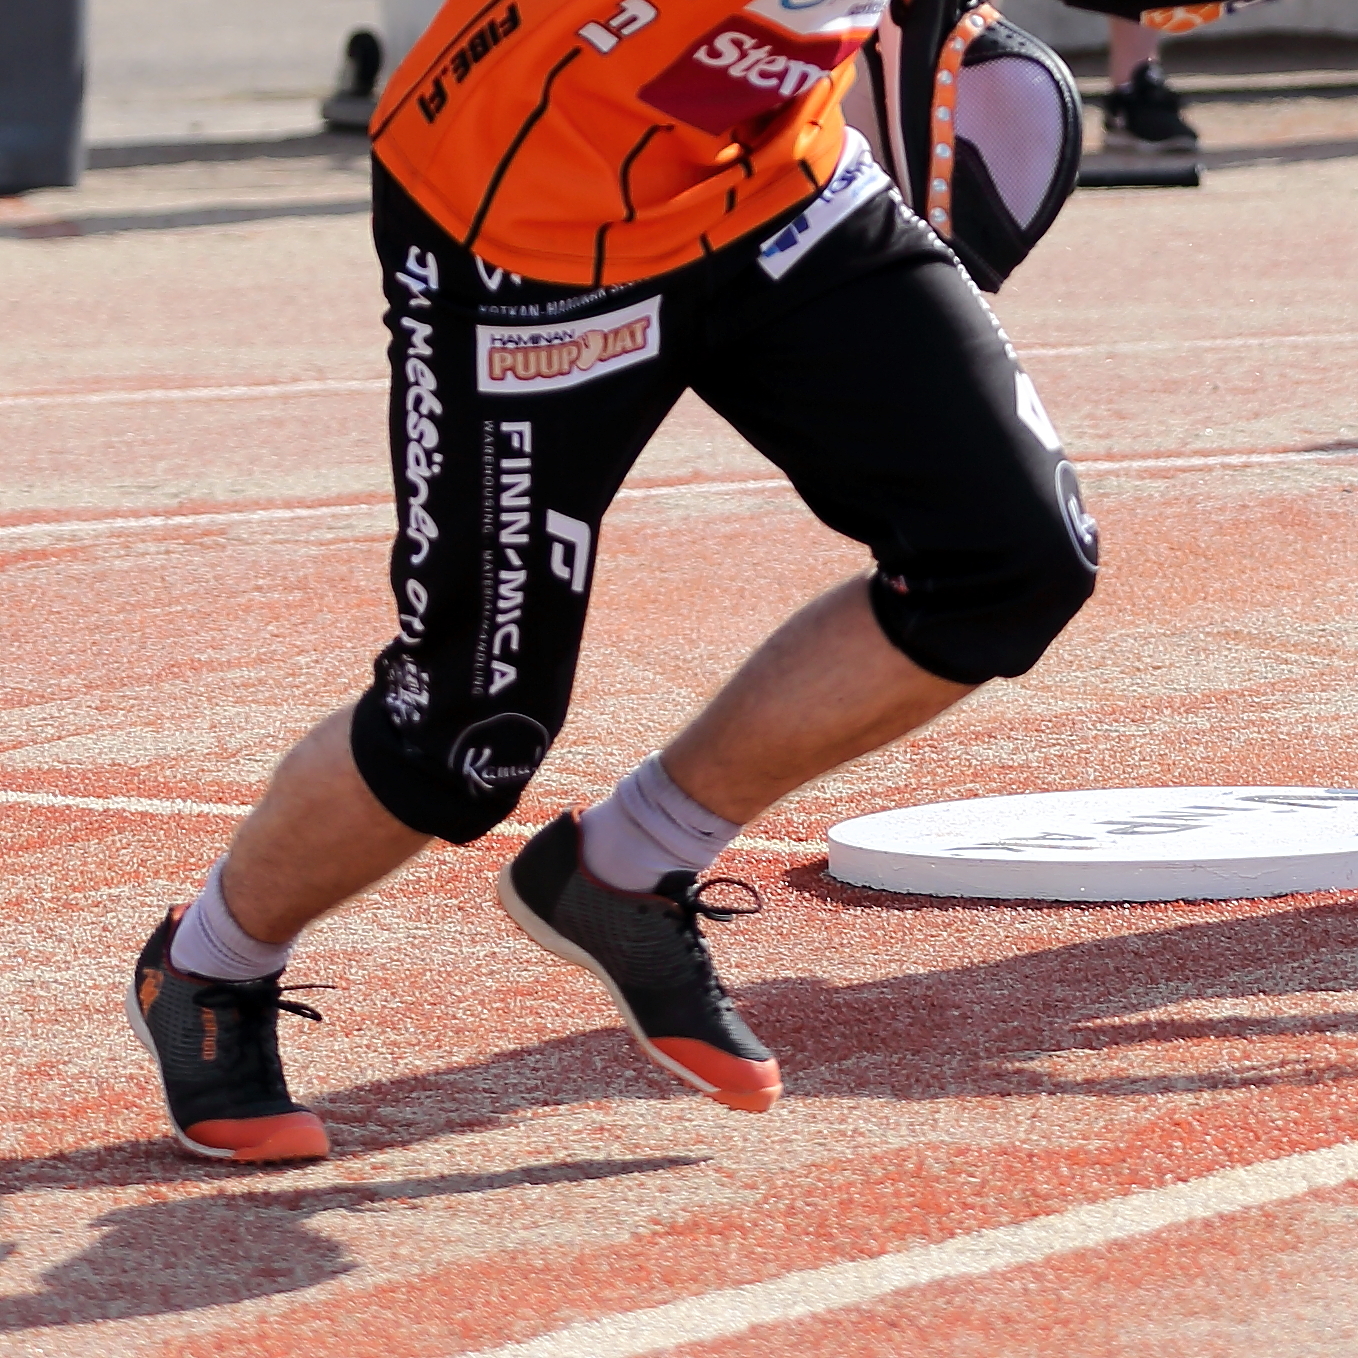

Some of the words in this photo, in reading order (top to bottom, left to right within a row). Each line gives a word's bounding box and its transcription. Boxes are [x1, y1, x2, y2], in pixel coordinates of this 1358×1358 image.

[416, 1, 522, 125] FIBE.FI
[490, 328, 576, 348] HAMINAN
[488, 420, 533, 698] FINN-MICA
